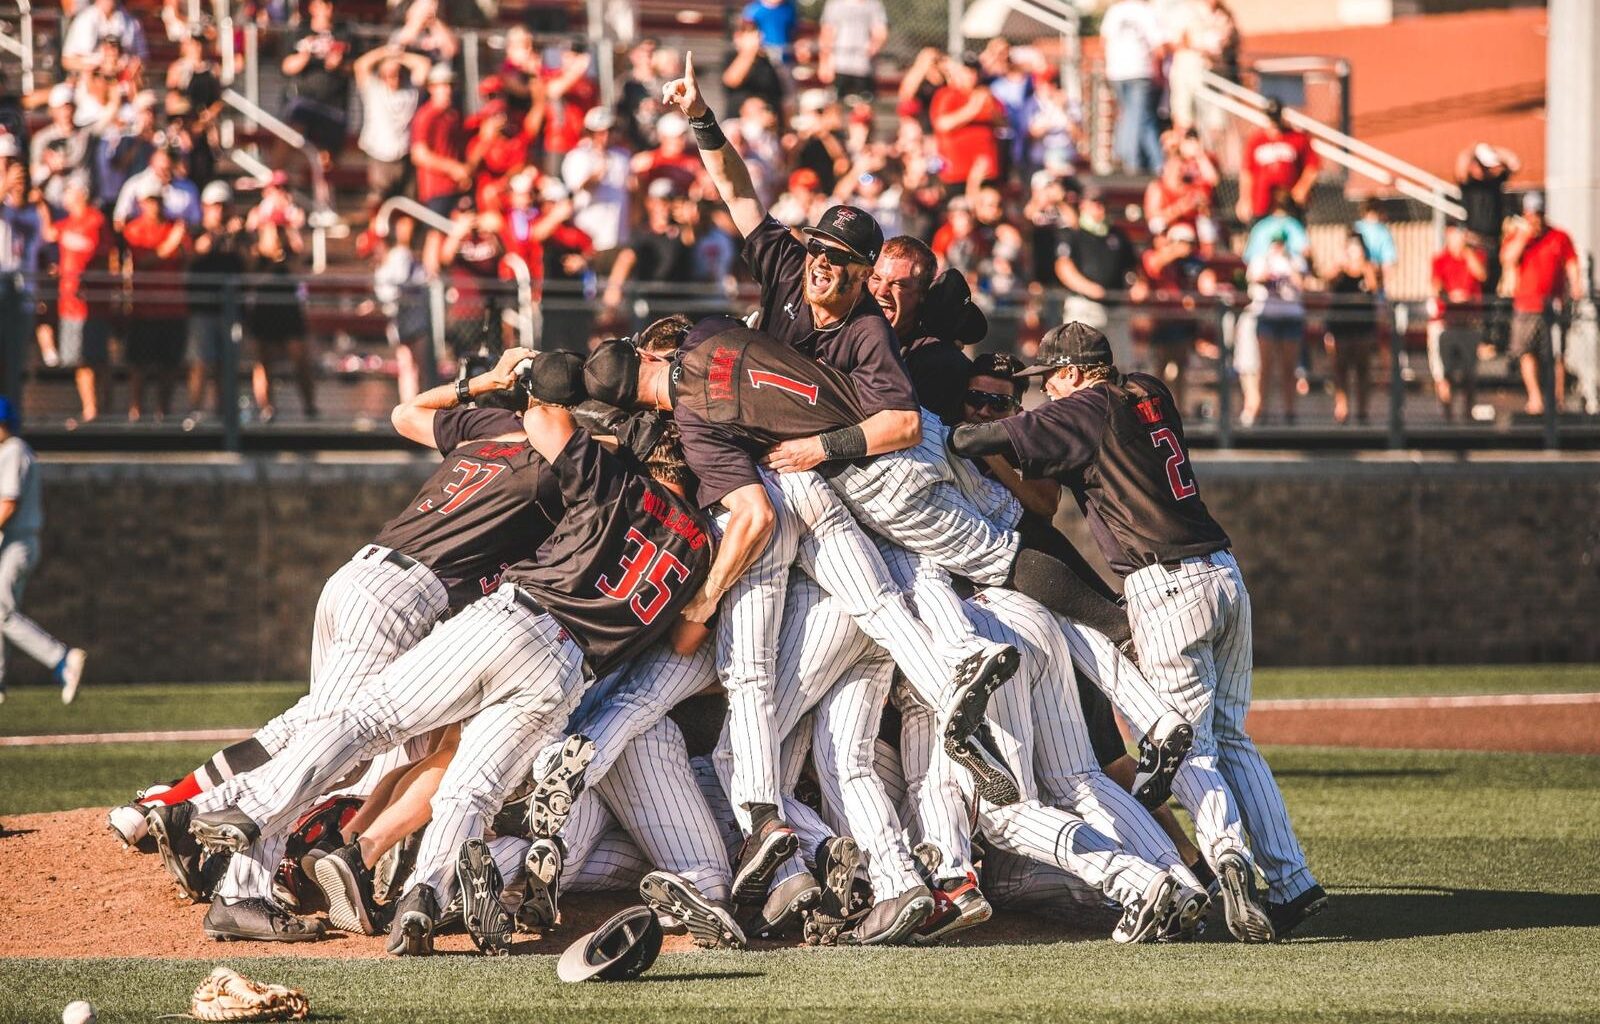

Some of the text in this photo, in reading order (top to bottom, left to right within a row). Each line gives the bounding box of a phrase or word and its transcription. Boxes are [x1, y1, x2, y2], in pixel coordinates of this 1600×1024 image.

[747, 369, 819, 406] 1
[417, 460, 507, 515] 37
[1150, 427, 1197, 501] 2
[642, 488, 707, 551] WILLEMS
[595, 526, 691, 625] 35
